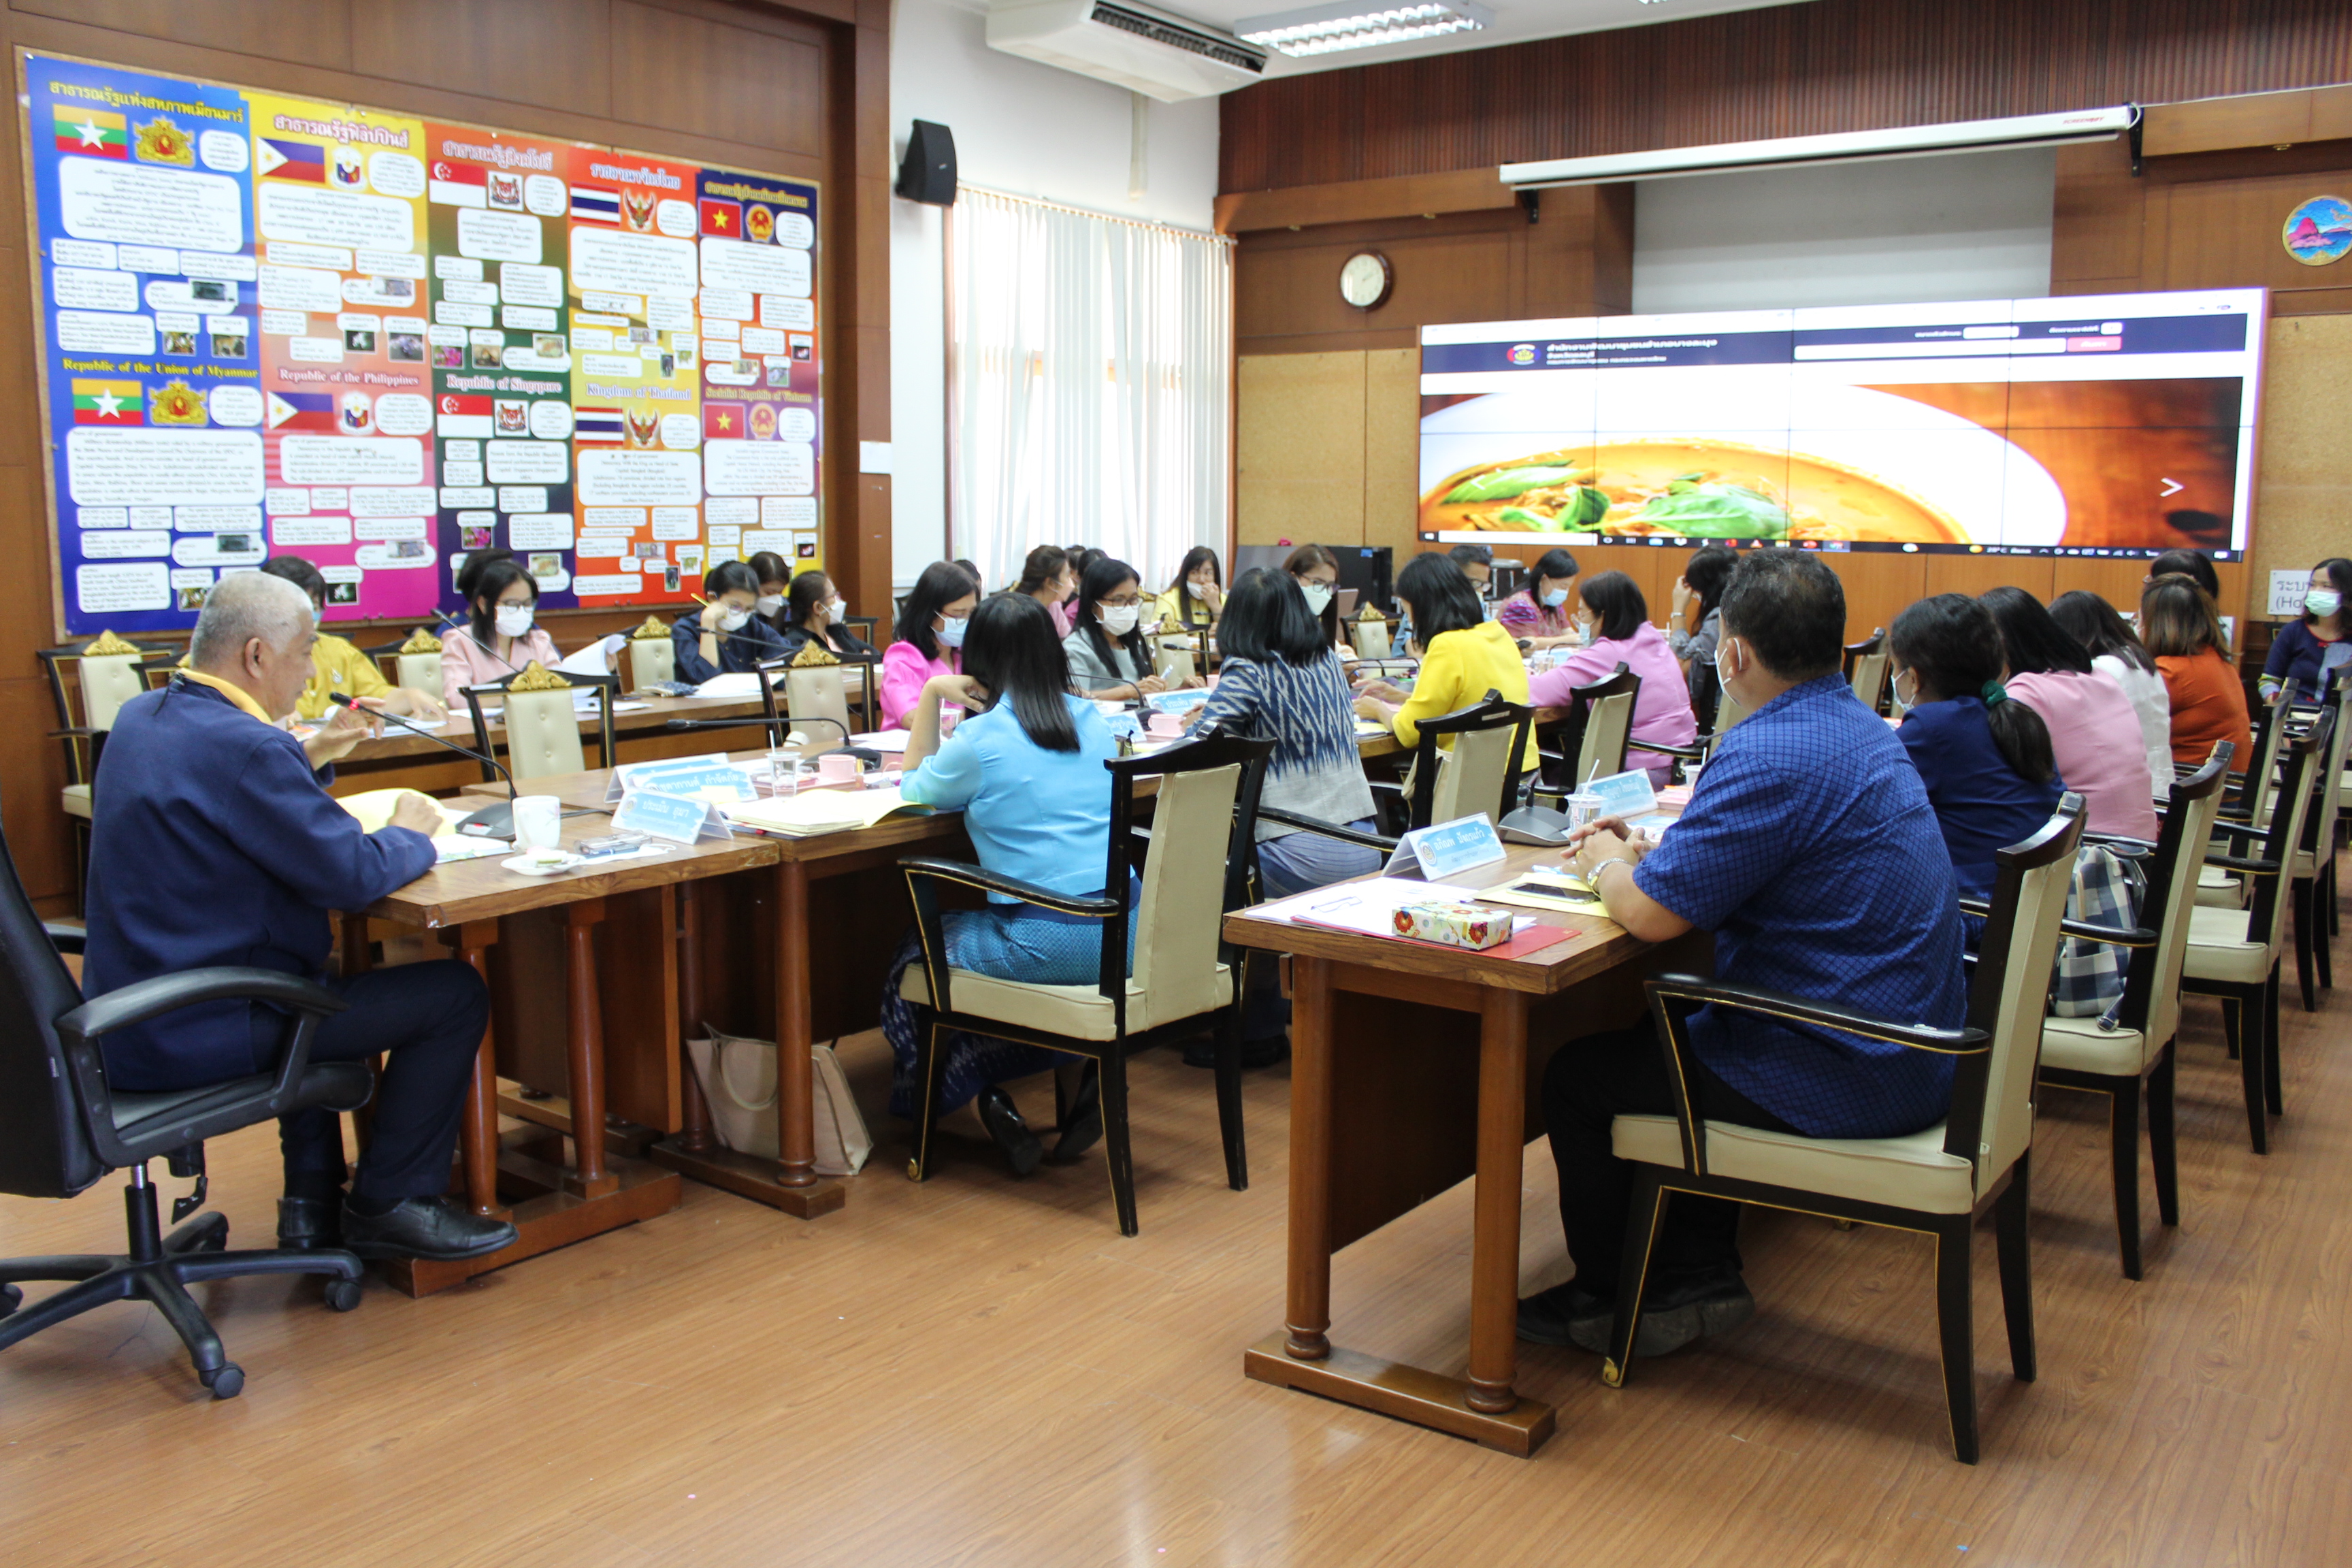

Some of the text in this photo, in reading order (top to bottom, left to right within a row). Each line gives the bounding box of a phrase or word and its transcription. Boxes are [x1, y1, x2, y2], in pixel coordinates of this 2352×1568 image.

[274, 114, 410, 149] สาธารณรัฐฟิลิปปินส์
[62, 357, 259, 379] Republic of the Union of Myanmar
[279, 368, 419, 387] Republic of the Philippines
[446, 374, 564, 395] Republic of Singapore
[586, 382, 691, 401] Kingdom of Thailand
[738, 387, 772, 402] Republic
[772, 390, 782, 401] of
[2276, 581, 2309, 592] ระบ
[2276, 596, 2304, 610] (Ho
